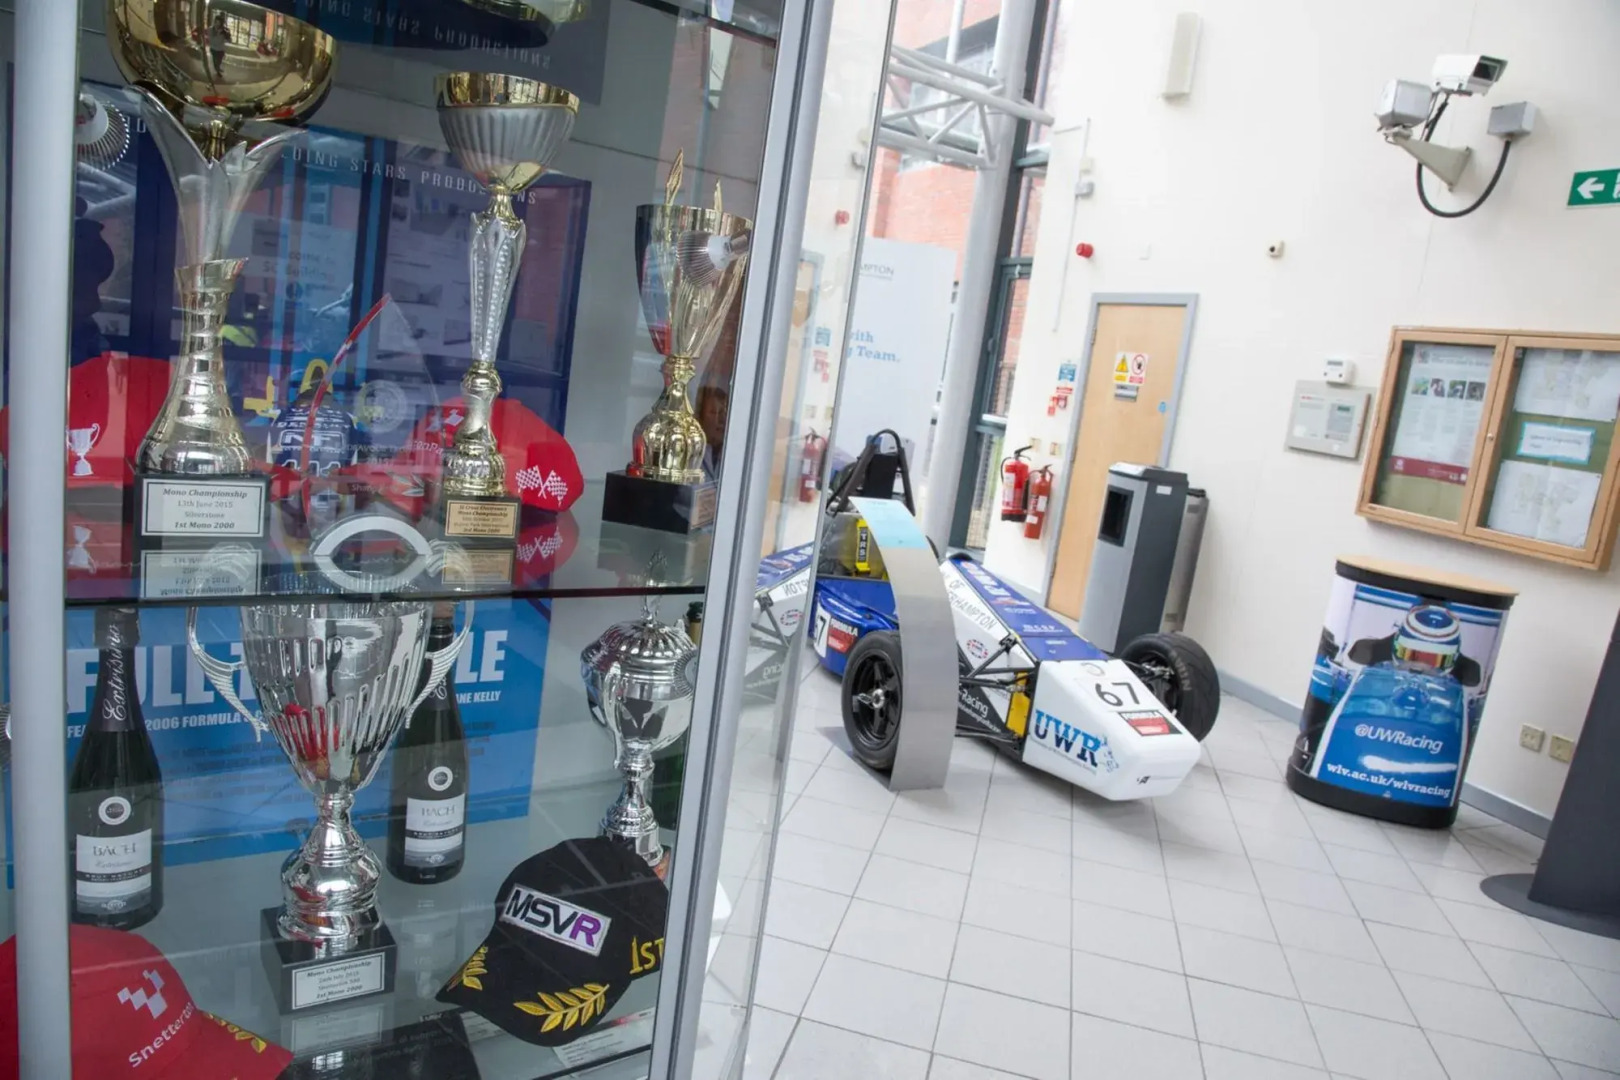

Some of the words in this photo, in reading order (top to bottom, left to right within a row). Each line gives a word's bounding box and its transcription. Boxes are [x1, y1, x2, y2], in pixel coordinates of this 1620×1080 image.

[350, 158, 407, 181] STARS
[163, 488, 187, 497] Mono
[188, 488, 248, 499] Championship
[177, 500, 195, 508] 13th
[196, 501, 213, 509] June
[214, 501, 234, 509] 2015
[175, 521, 188, 529] 1st
[473, 690, 501, 703] KELLY
[1094, 682, 1140, 708] 67
[182, 714, 241, 727] FORMULA
[1034, 708, 1101, 768] UWR
[1354, 723, 1444, 755] @UWRacing
[1326, 761, 1452, 799] wlv.ac.uk/wlvracing
[421, 804, 457, 817] BACH
[505, 888, 602, 948] MSVR
